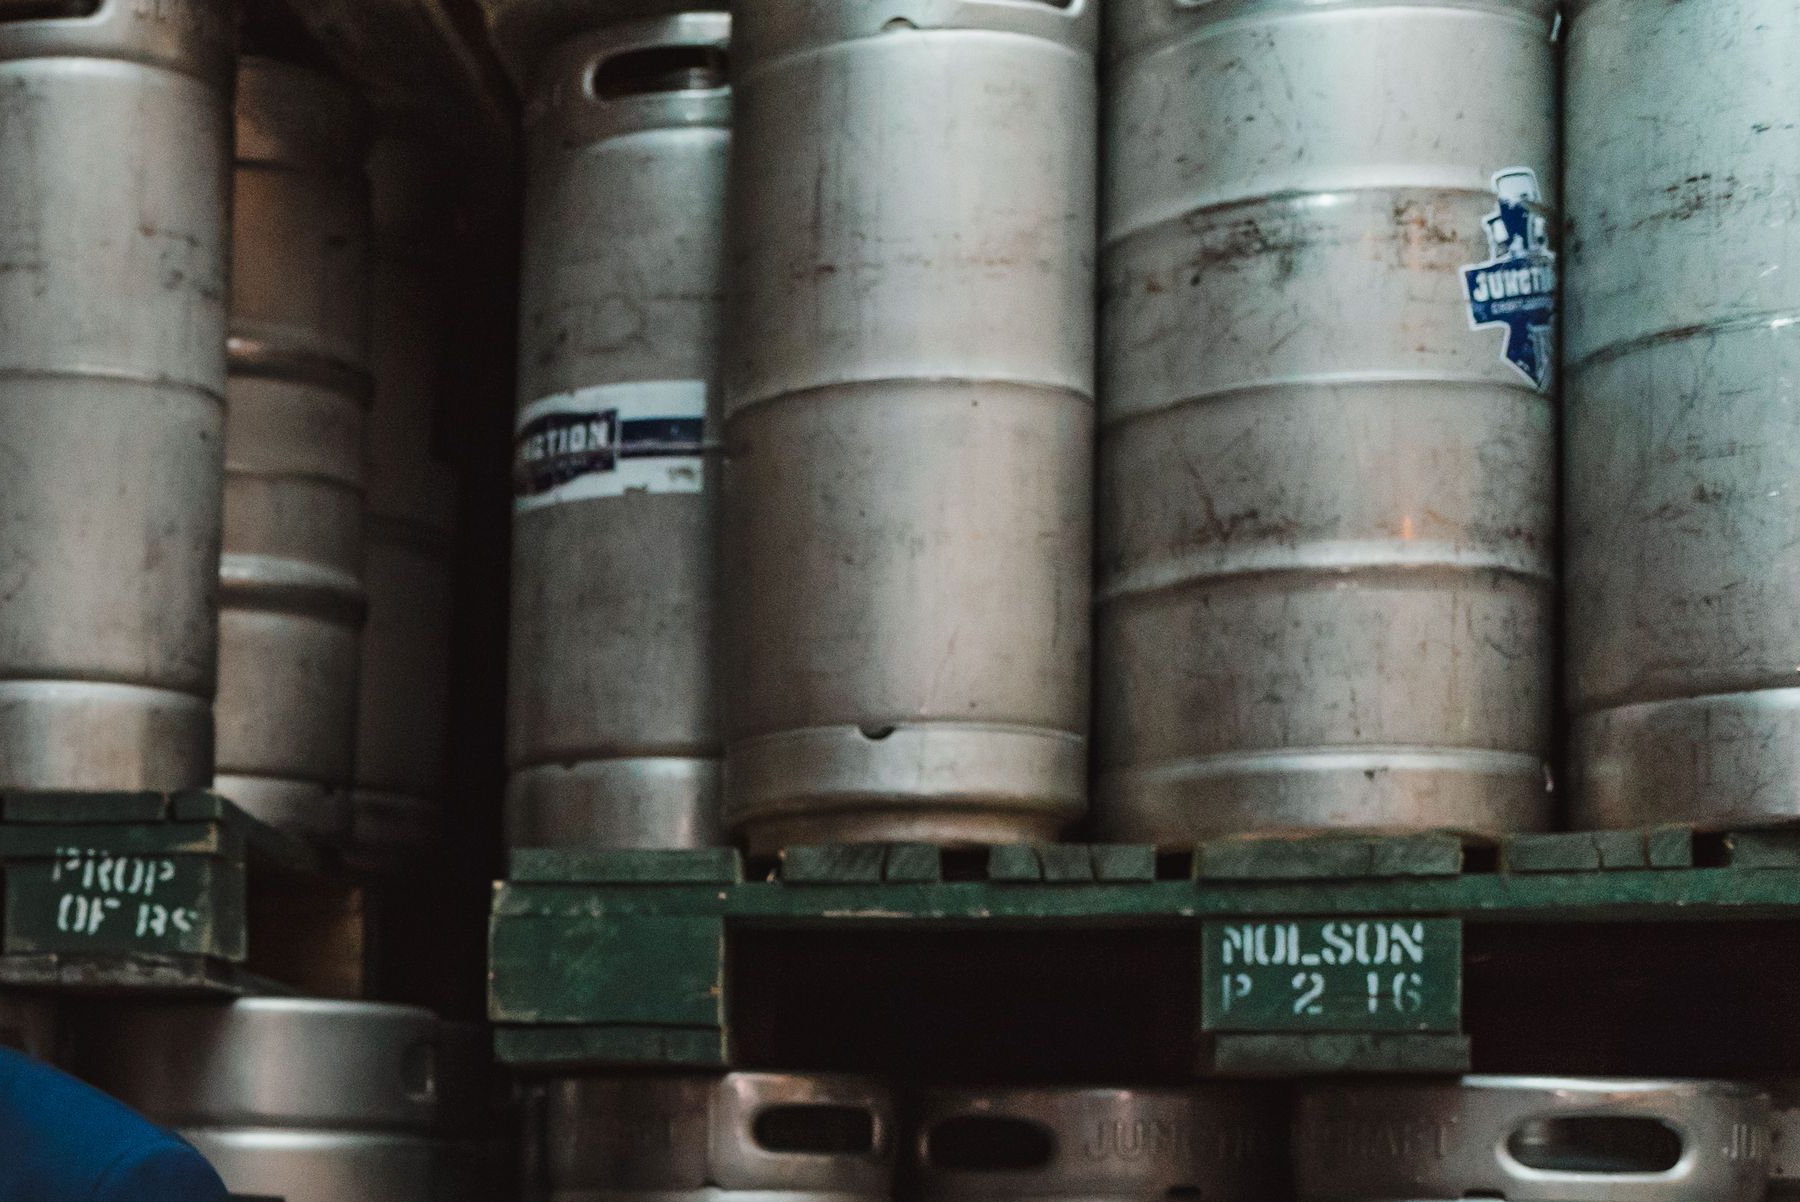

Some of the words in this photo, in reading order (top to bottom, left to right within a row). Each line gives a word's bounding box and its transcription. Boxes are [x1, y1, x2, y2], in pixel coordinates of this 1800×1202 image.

[52, 846, 177, 897] PROP
[57, 892, 121, 936] OF
[1221, 921, 1425, 967] MOLSON
[1221, 972, 1252, 1014] P
[1291, 971, 1326, 1014] 2
[1365, 970, 1424, 1014] 16
